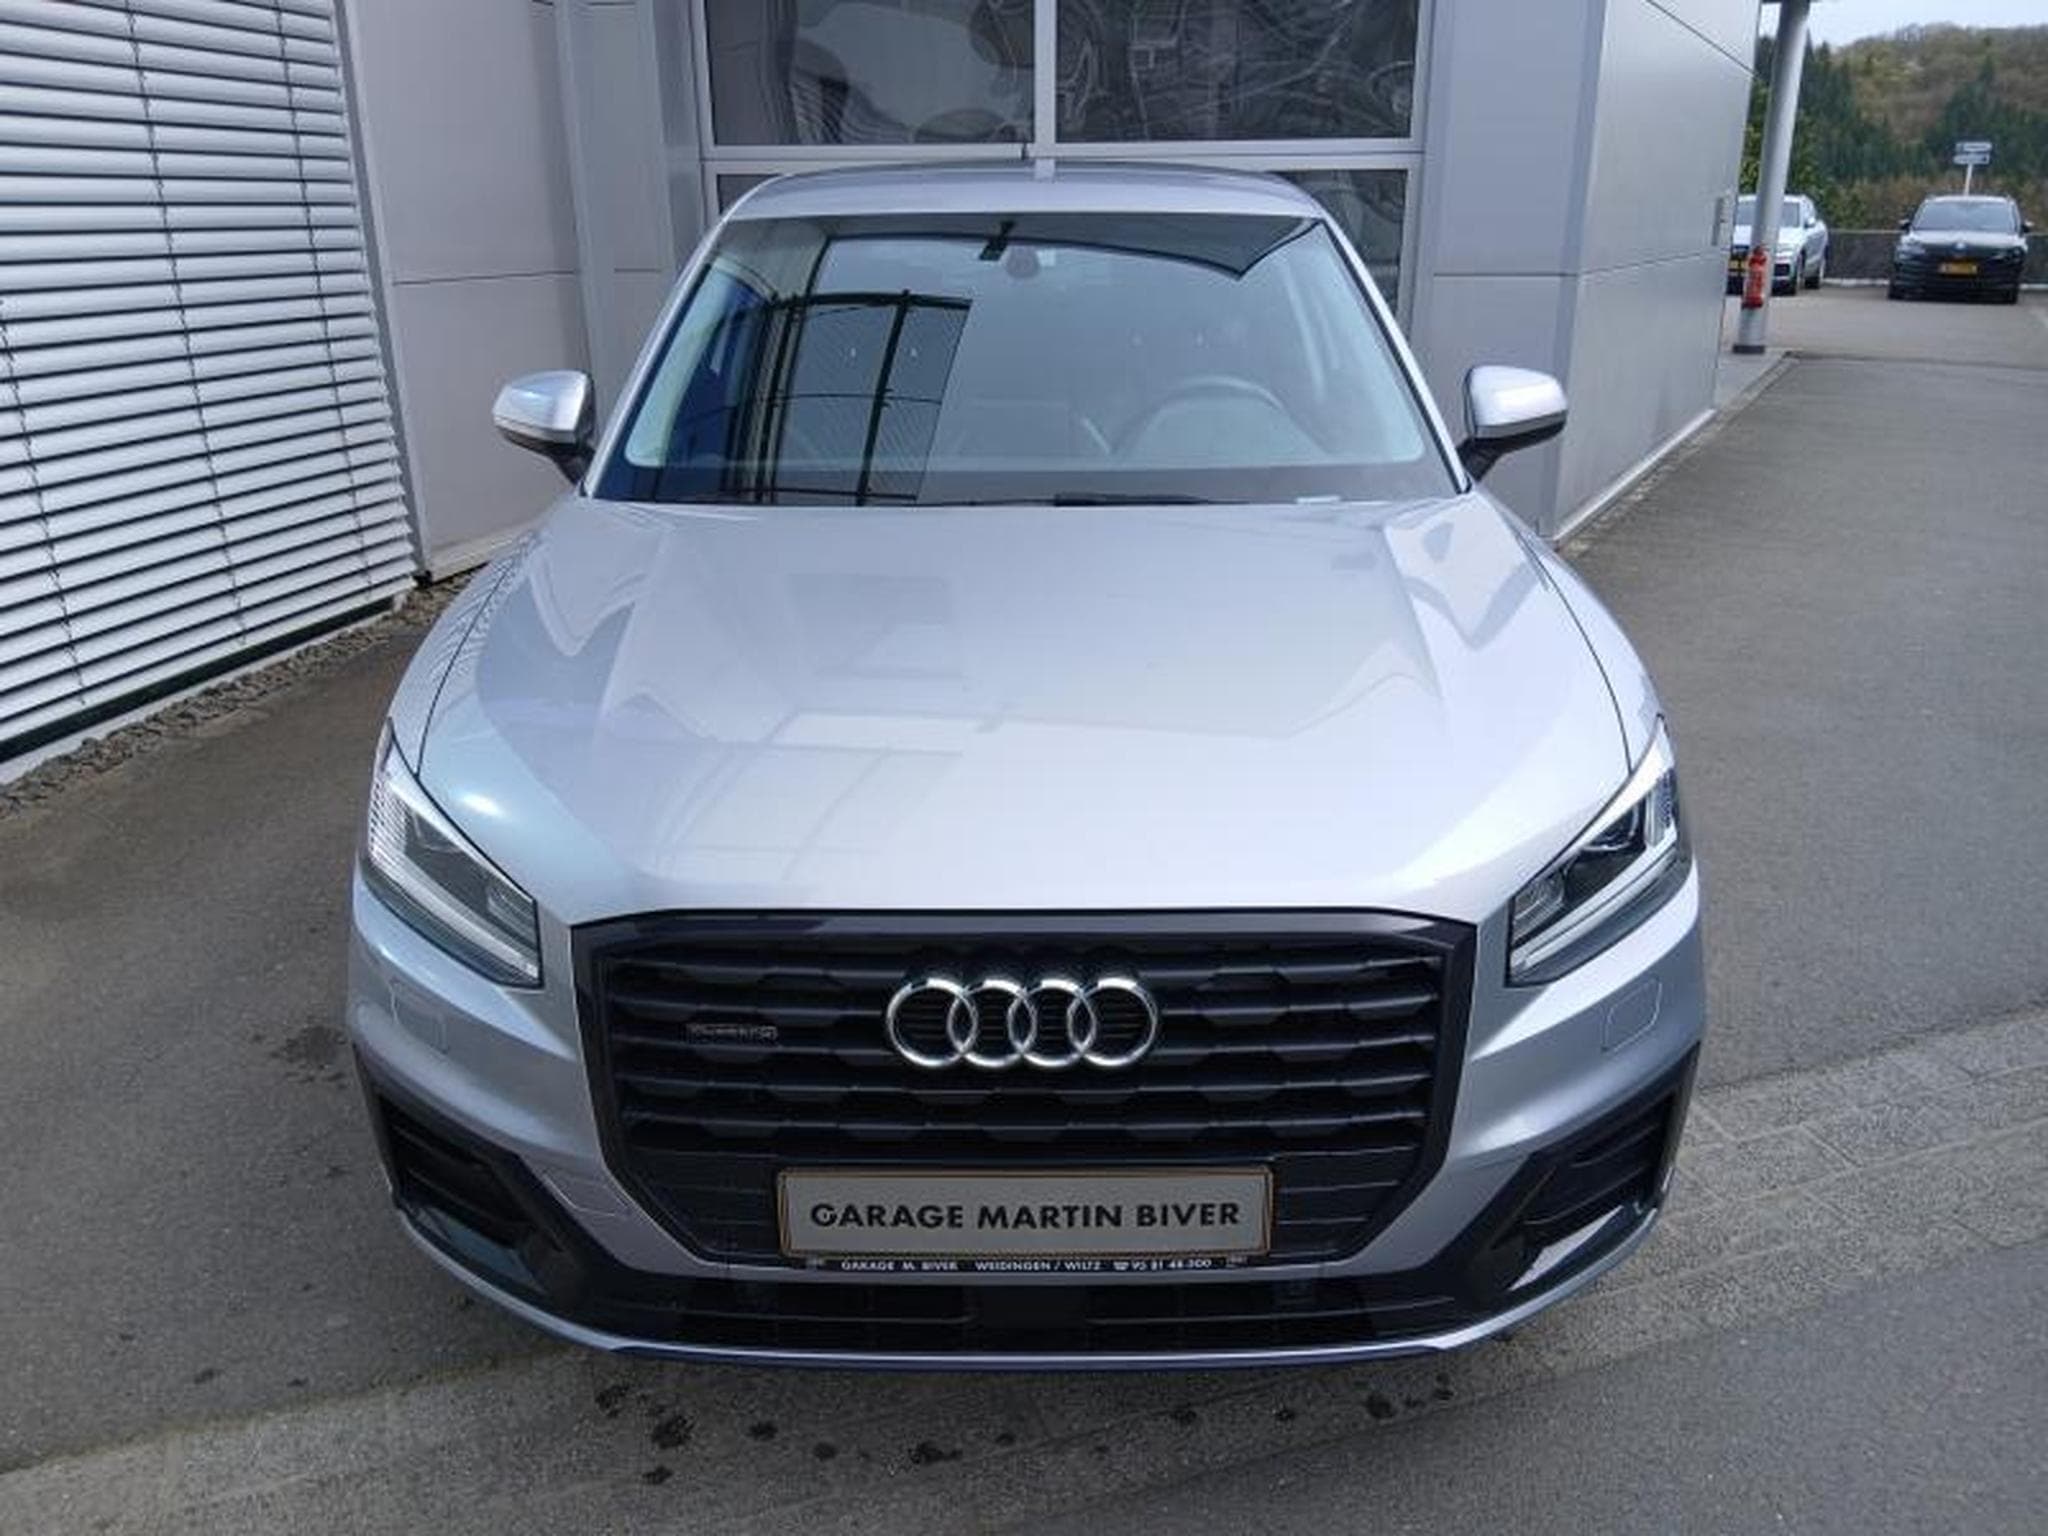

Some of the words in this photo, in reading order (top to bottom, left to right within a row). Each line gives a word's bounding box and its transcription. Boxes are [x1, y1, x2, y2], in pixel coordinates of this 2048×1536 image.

[811, 1203, 963, 1228] GARAGE
[978, 1203, 1123, 1228] MARTIN
[1137, 1202, 1240, 1227] BIVER
